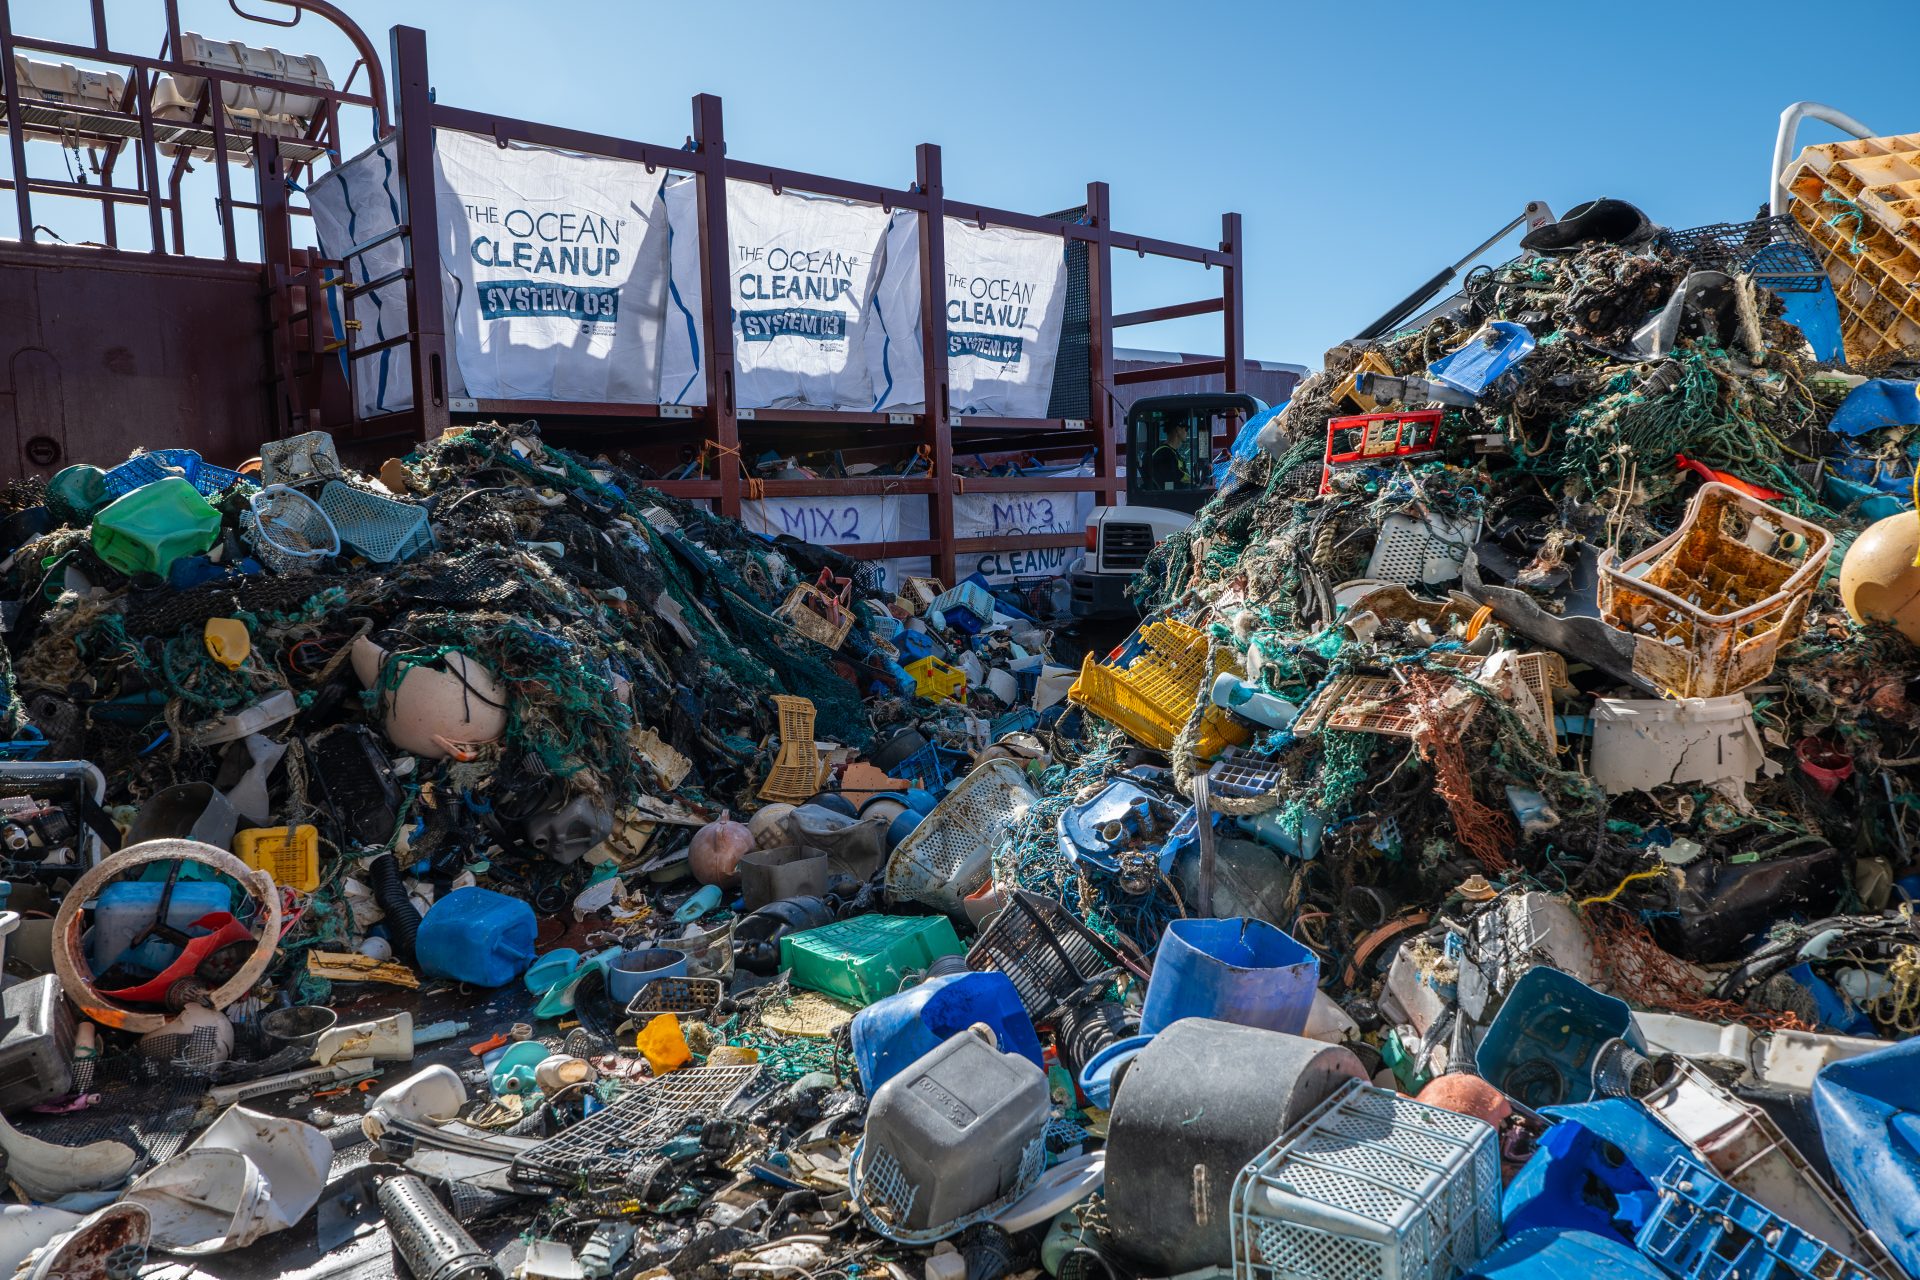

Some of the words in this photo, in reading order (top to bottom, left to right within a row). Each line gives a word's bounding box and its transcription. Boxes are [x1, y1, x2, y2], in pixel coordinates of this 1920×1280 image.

[465, 204, 499, 224] THE
[470, 235, 620, 277] CLEANUP
[738, 245, 764, 261] THE
[739, 273, 853, 301] CLEANUP
[948, 273, 967, 289] THE
[487, 286, 577, 313] SYSTEM
[583, 292, 614, 316] 03
[744, 311, 817, 336] SYSTEM
[820, 315, 840, 335] 03
[976, 547, 1066, 577] CLEANUP
